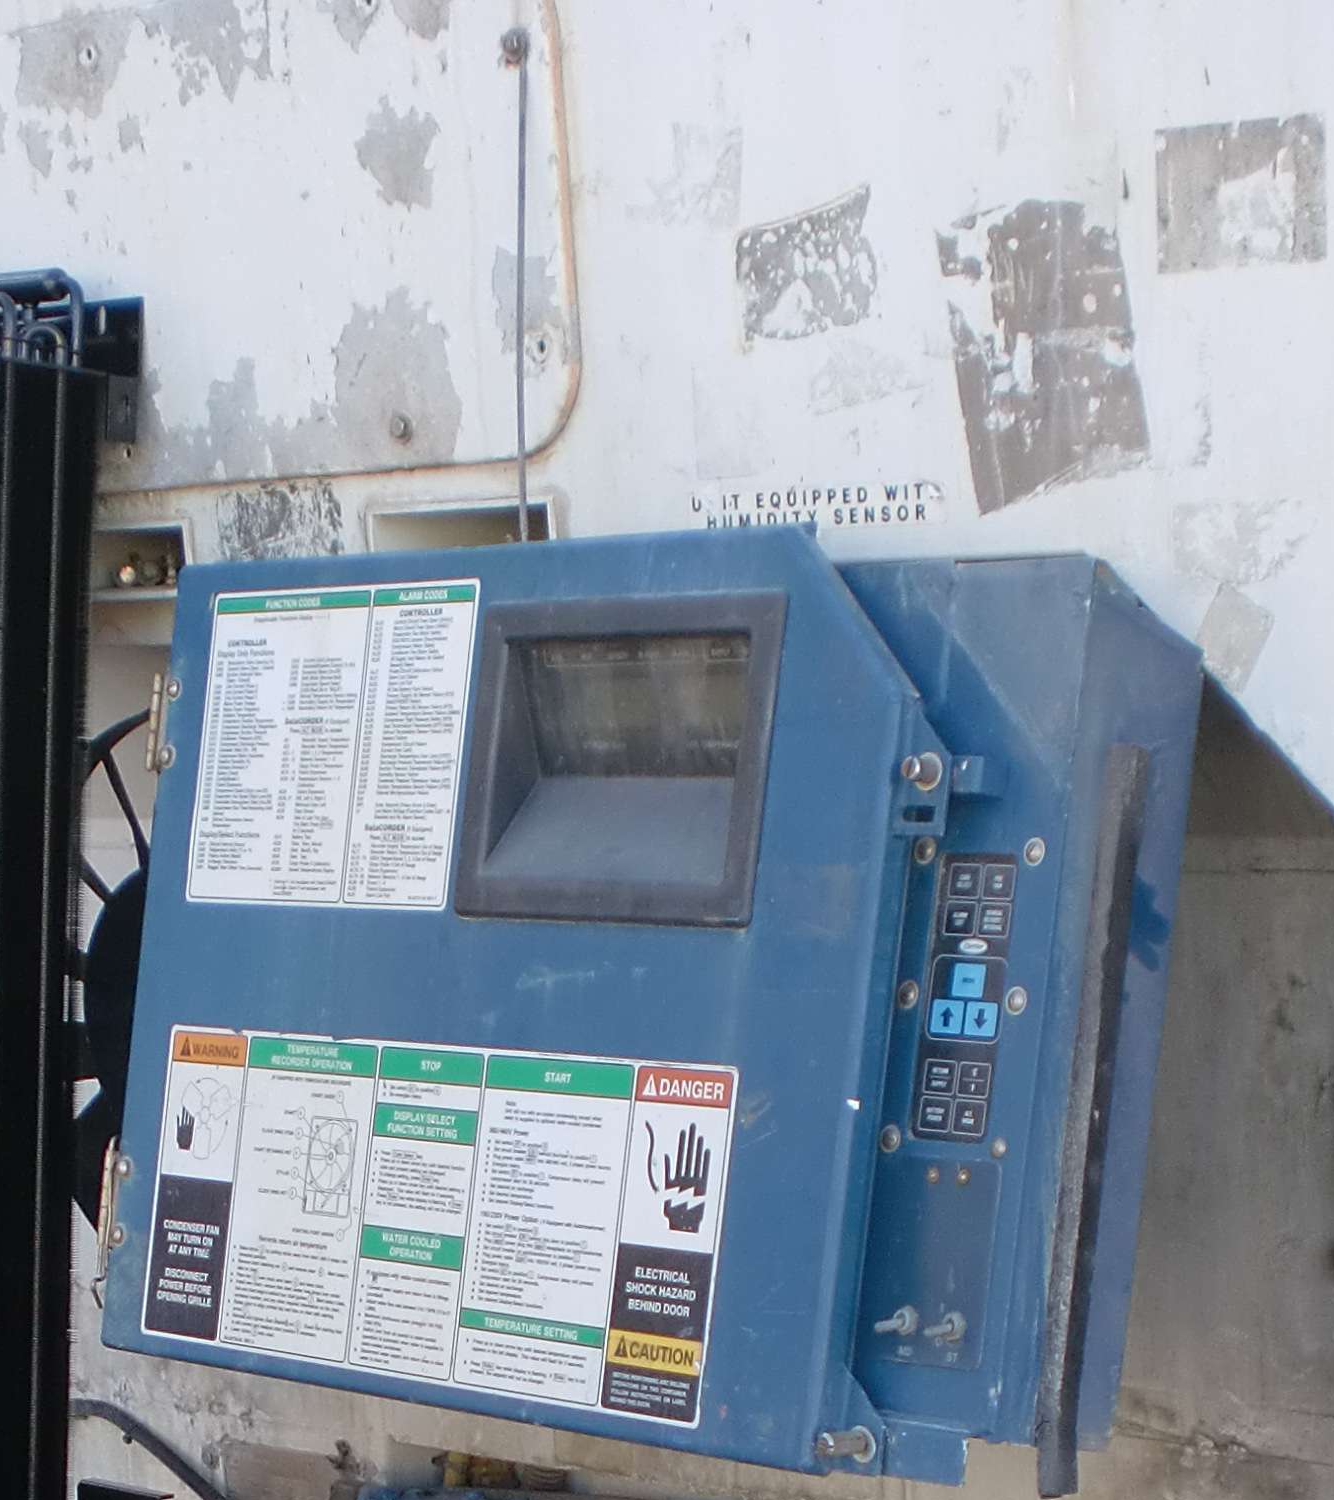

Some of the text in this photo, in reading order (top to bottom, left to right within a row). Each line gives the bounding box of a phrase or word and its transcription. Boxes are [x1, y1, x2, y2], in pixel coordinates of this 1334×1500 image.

[691, 482, 939, 512] UIT EQUIPPED WIT
[834, 504, 926, 525] SENSOR
[192, 1043, 239, 1059] WARNING
[287, 1044, 339, 1058] TEMPERATURE
[271, 1055, 353, 1071] RECORDER OPERATION
[420, 1060, 442, 1072] STOP
[544, 1072, 571, 1084] START
[659, 1079, 725, 1101] DANGER
[163, 1219, 220, 1236] CONDENSER FAN
[167, 1232, 213, 1247] MAY TURN ON
[409, 1235, 442, 1249] COOLED
[168, 1244, 210, 1259] AT ANY TIME
[165, 1267, 209, 1283] DISCONNECT
[635, 1266, 691, 1285] ELECTRICAL
[158, 1279, 213, 1296] POWER BEFORE
[625, 1281, 697, 1302] SHOCK HAZARD
[156, 1290, 212, 1307] OPENING GRILLE
[628, 1298, 691, 1318] BEHIND DOOR
[484, 1317, 578, 1341] TEMPERATURE SETTING
[629, 1341, 695, 1367] CAUTION
